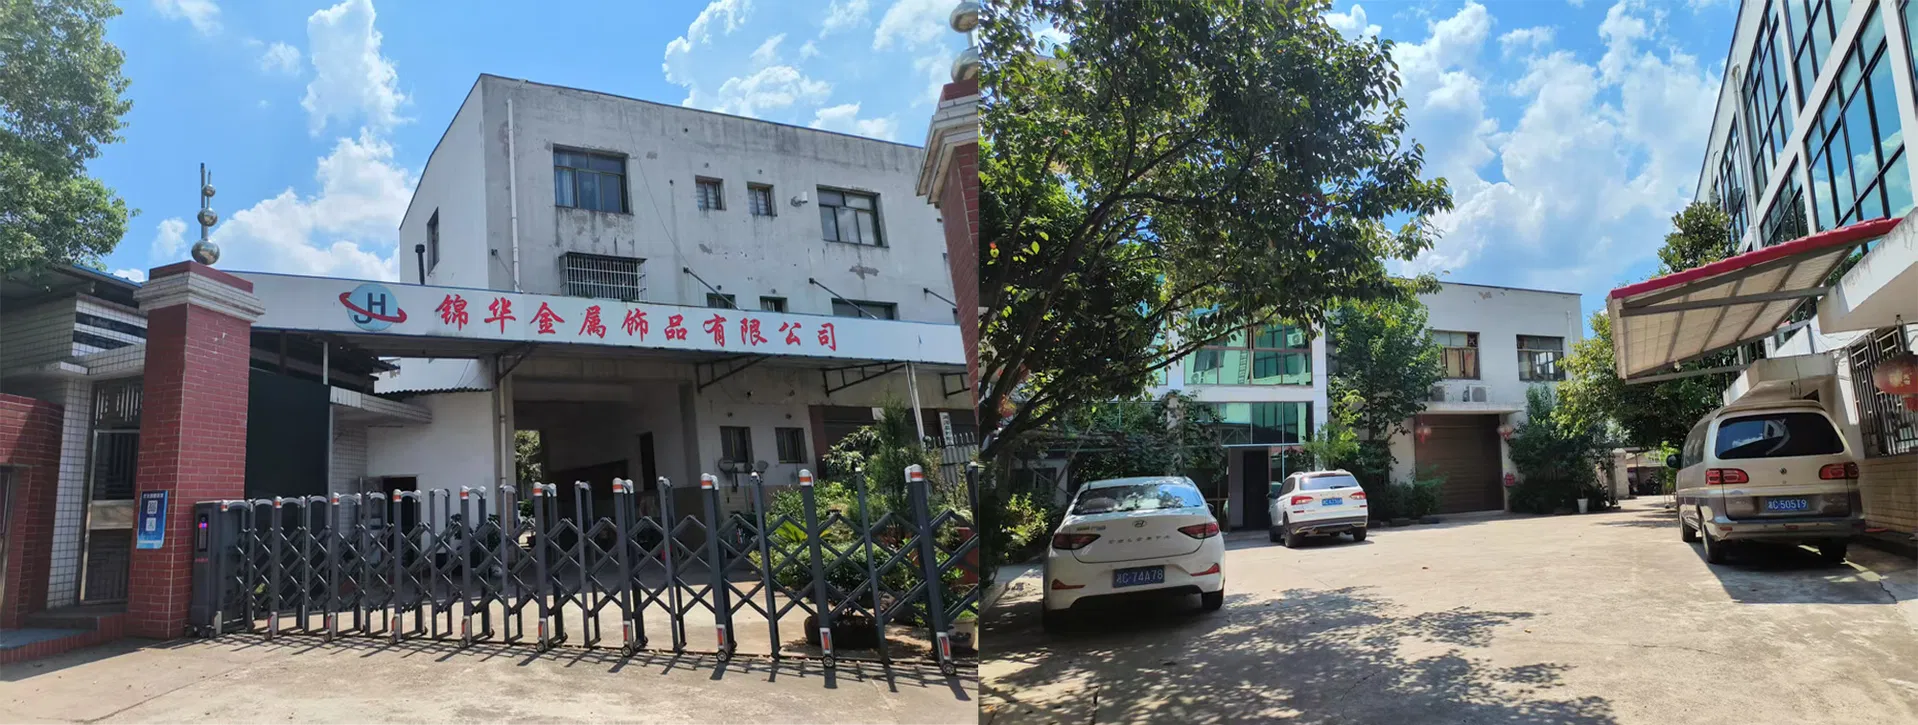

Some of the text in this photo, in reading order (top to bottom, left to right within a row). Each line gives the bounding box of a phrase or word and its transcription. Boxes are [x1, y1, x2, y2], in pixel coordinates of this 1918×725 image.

[435, 294, 836, 351] 锦华金属饰品有限公司
